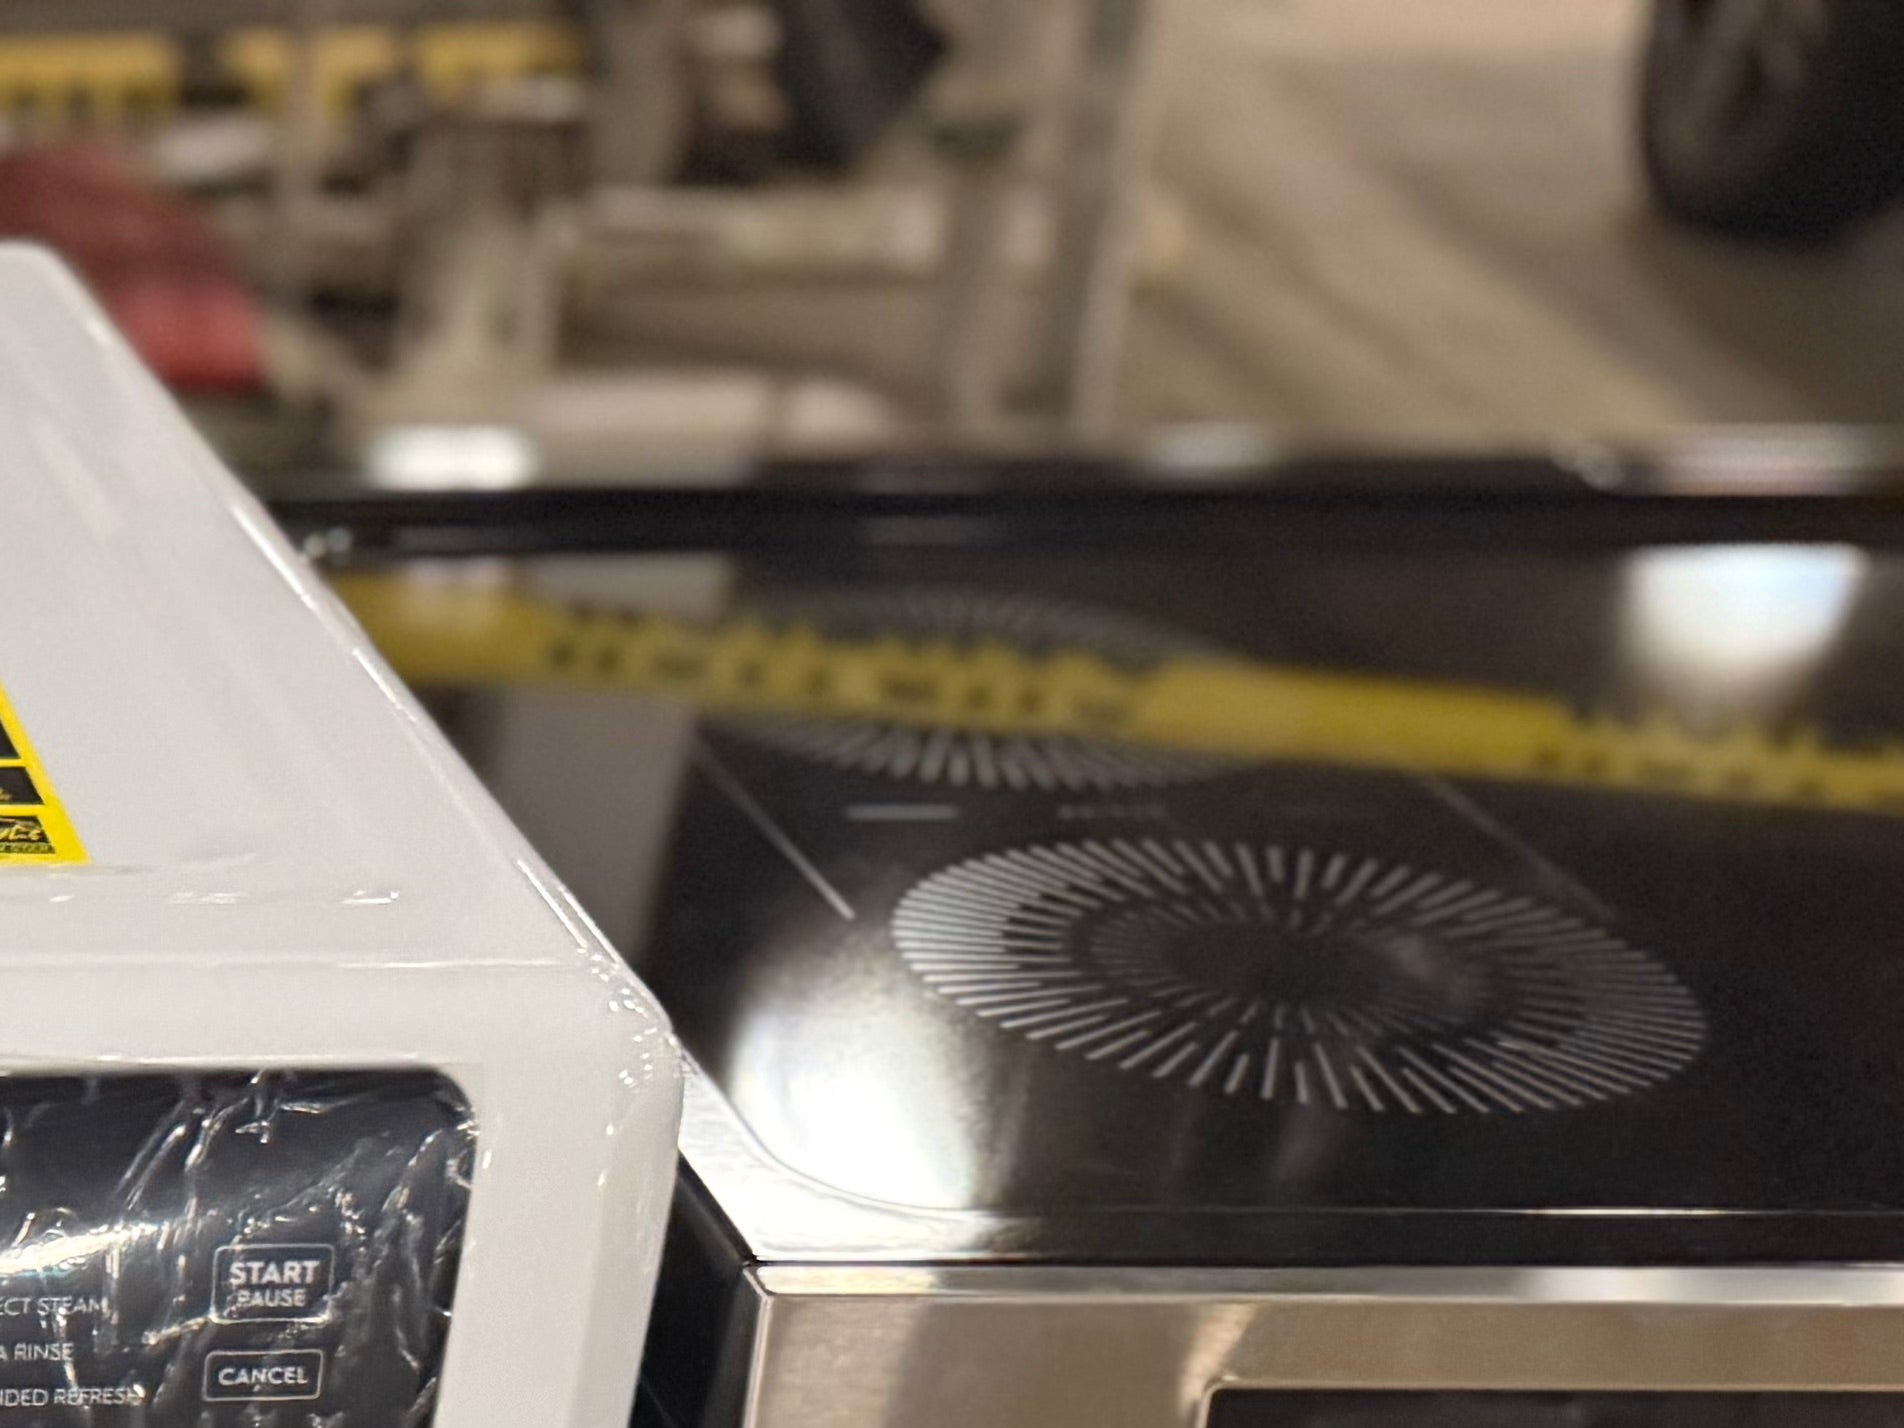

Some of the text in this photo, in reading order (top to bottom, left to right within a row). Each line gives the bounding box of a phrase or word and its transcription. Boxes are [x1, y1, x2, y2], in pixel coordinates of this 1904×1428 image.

[227, 1260, 321, 1286] START
[236, 1288, 307, 1308] PAUSE
[14, 1343, 74, 1361] RINSE
[217, 1367, 309, 1386] CANCEL
[54, 1387, 145, 1406] REFRESH
